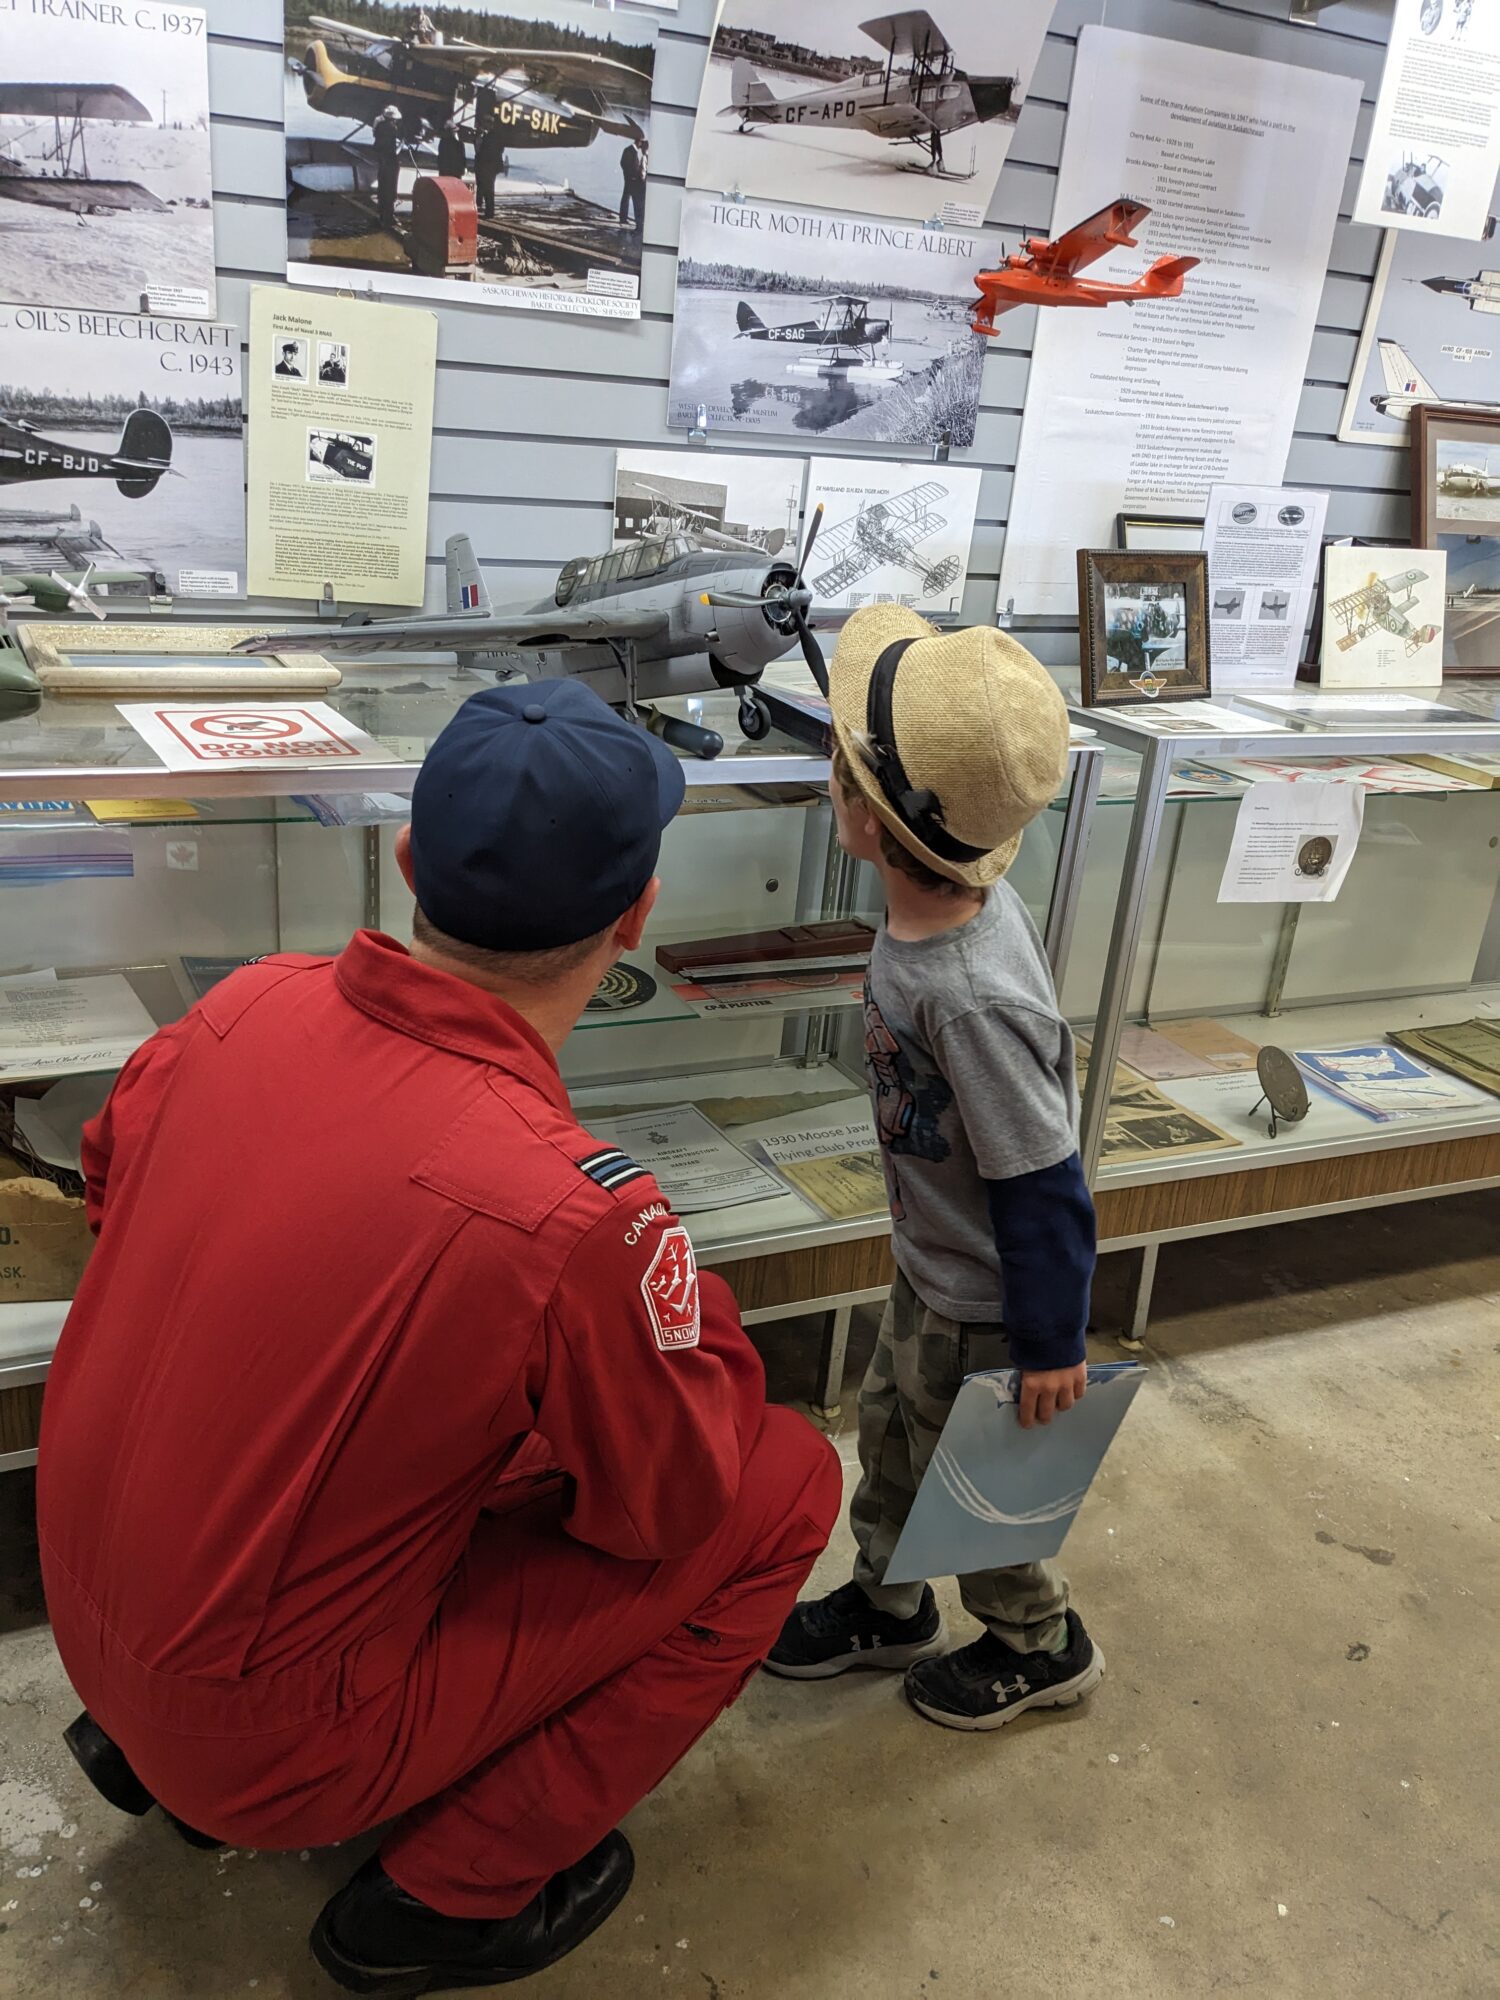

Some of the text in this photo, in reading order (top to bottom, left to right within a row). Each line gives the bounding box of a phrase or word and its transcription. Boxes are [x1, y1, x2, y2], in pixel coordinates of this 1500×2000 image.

[134, 9, 156, 30] C.
[162, 13, 204, 36] 1937
[710, 205, 976, 258] TIGER MOTH AT PRINCE ALBERT
[482, 286, 538, 300] SASKATCHEWAN
[539, 292, 566, 302] HISTORY
[575, 296, 610, 307] FOLKLORE
[612, 300, 639, 310] SOCIETY
[531, 302, 553, 310] BAKER
[554, 302, 598, 314] COLLECTION
[15, 309, 235, 348] OIL'S BEECHCRAFT
[273, 314, 312, 326] Jack Malone
[768, 328, 805, 340] CF-SAG
[160, 352, 234, 376] C. 1943
[25, 449, 98, 472] CF-BJD
[200, 740, 336, 750] DO NOT
[210, 747, 342, 757] TOUCH
[728, 1000, 773, 1009] PLOTTER
[762, 1124, 870, 1148] 1930 Moose Jaw
[772, 1138, 878, 1162] Flying Club Prog
[664, 1325, 697, 1342] SNOW
